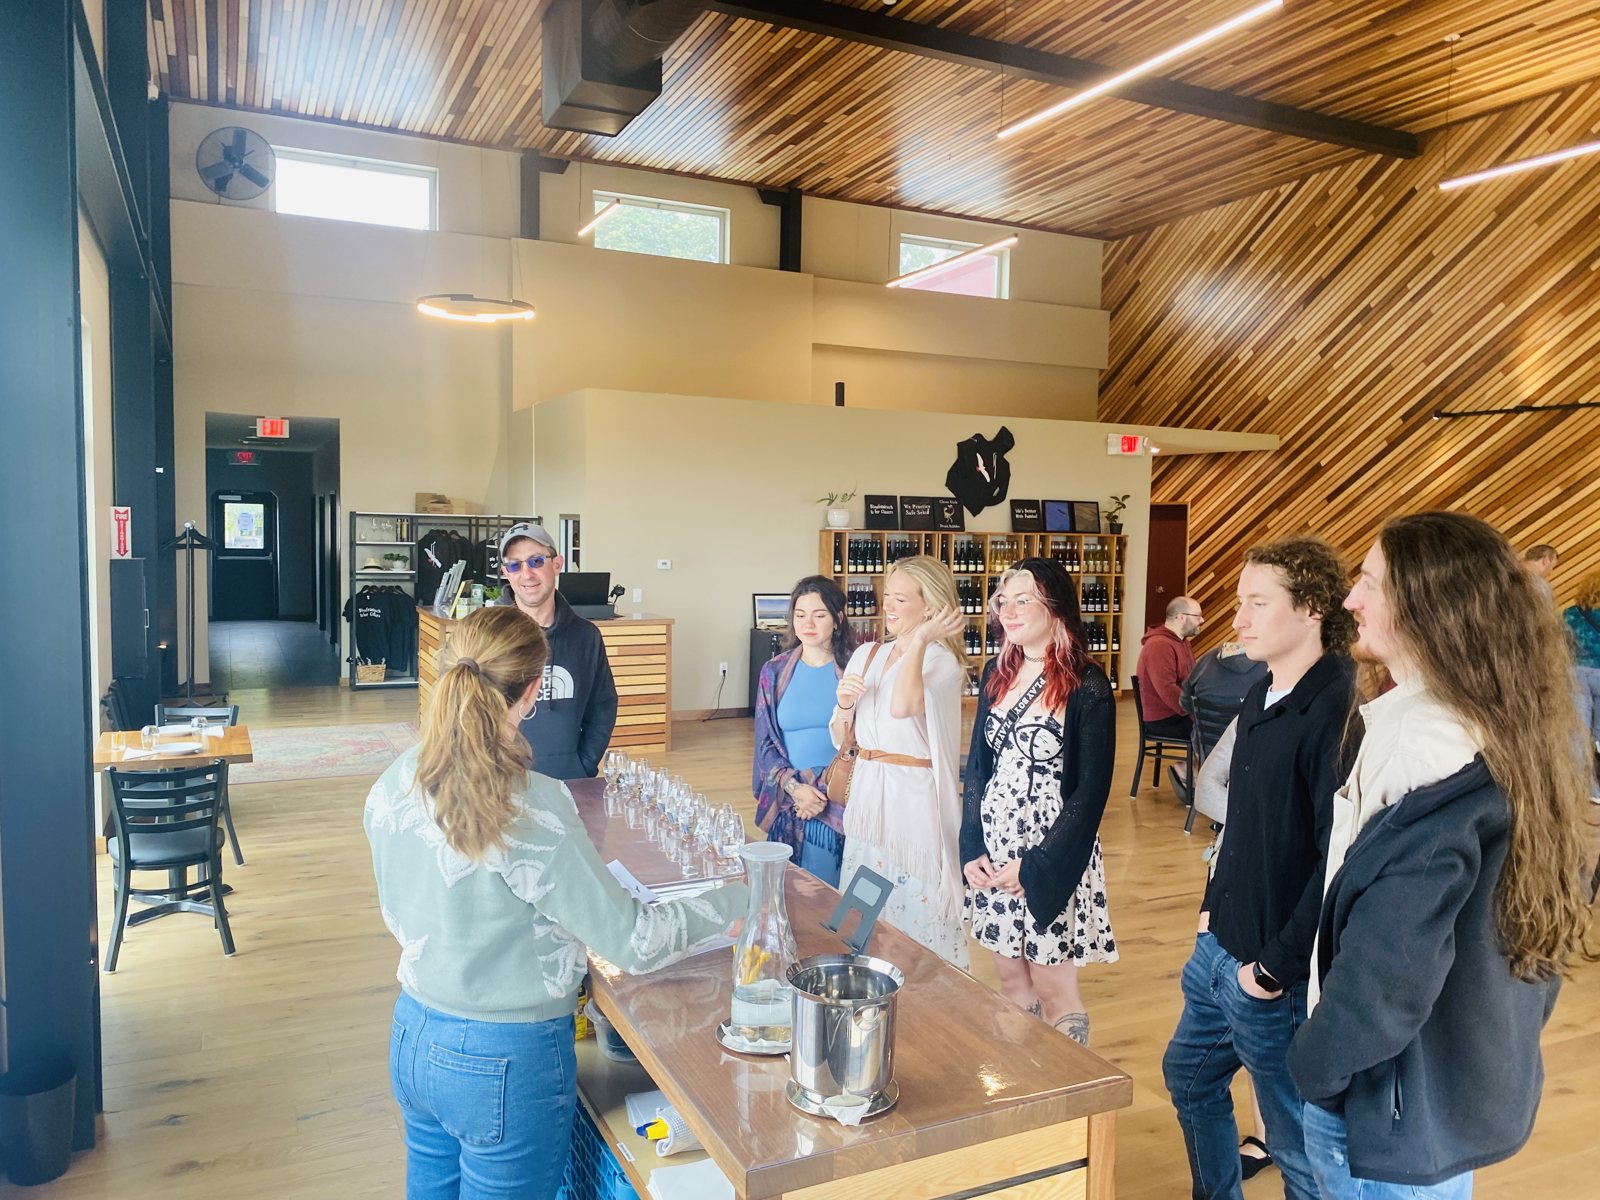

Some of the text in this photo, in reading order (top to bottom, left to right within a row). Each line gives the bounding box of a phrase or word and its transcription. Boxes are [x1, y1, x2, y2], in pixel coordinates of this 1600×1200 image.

[262, 418, 284, 436] EXIT
[1121, 435, 1139, 453] EXIT
[236, 451, 253, 461] EXIT
[536, 689, 551, 701] CE
[1013, 677, 1046, 715] PLAYBOY
